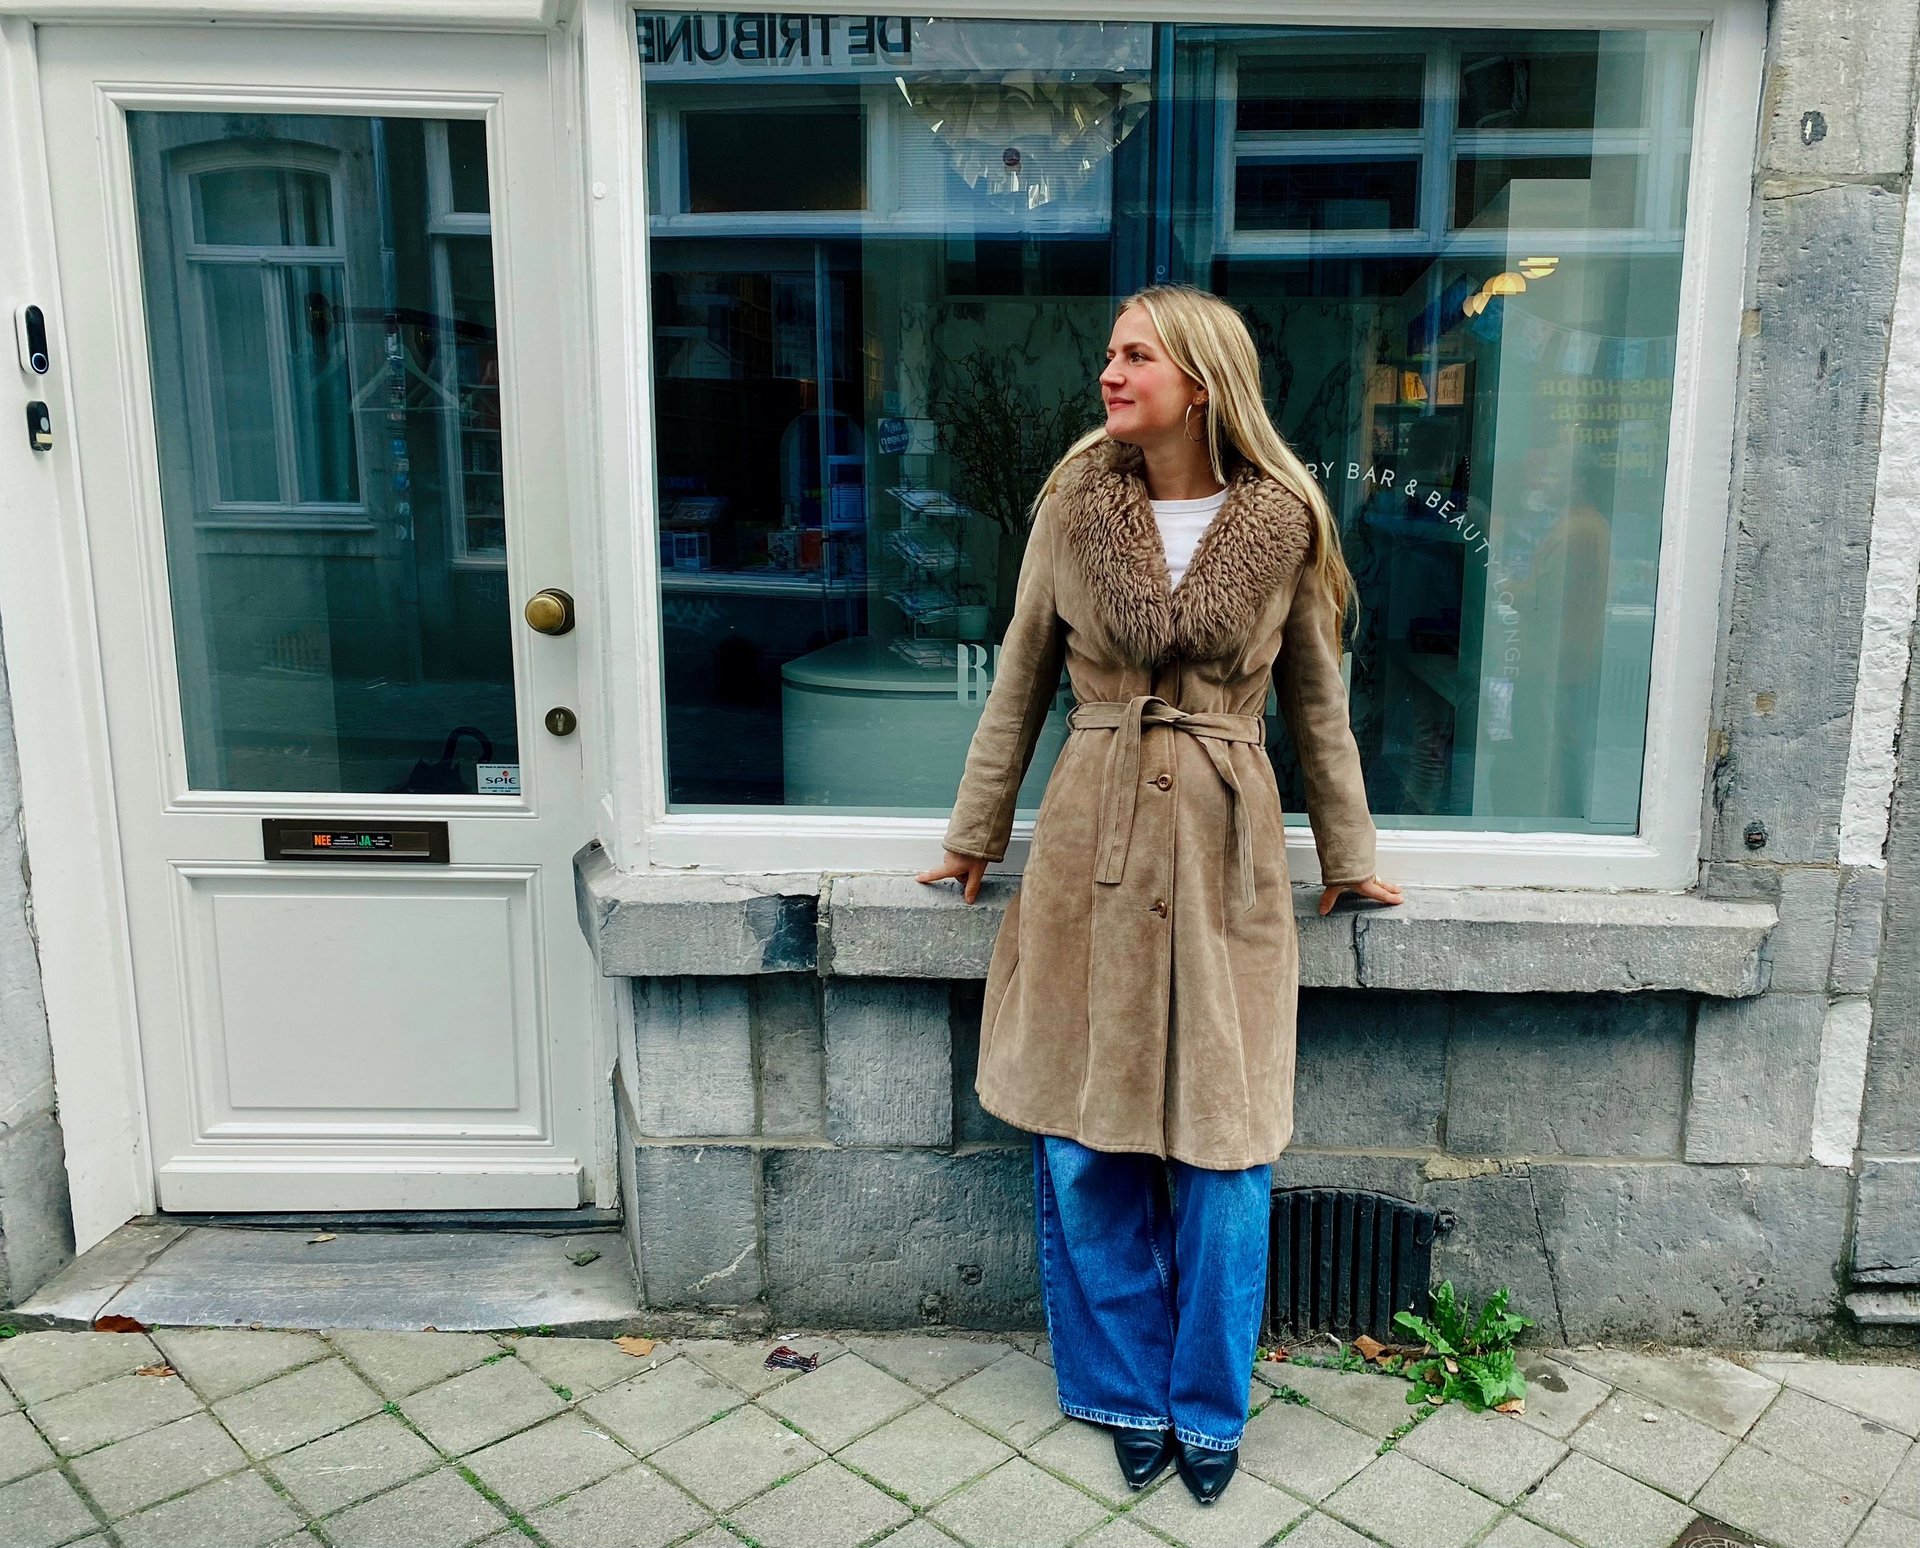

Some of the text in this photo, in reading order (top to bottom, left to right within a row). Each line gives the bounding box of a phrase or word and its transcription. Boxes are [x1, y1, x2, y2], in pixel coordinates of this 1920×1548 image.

[1305, 461, 1520, 677] RY BAR & BEAUTY LOUNGE
[314, 834, 332, 846] NEE
[359, 834, 371, 846] JA
